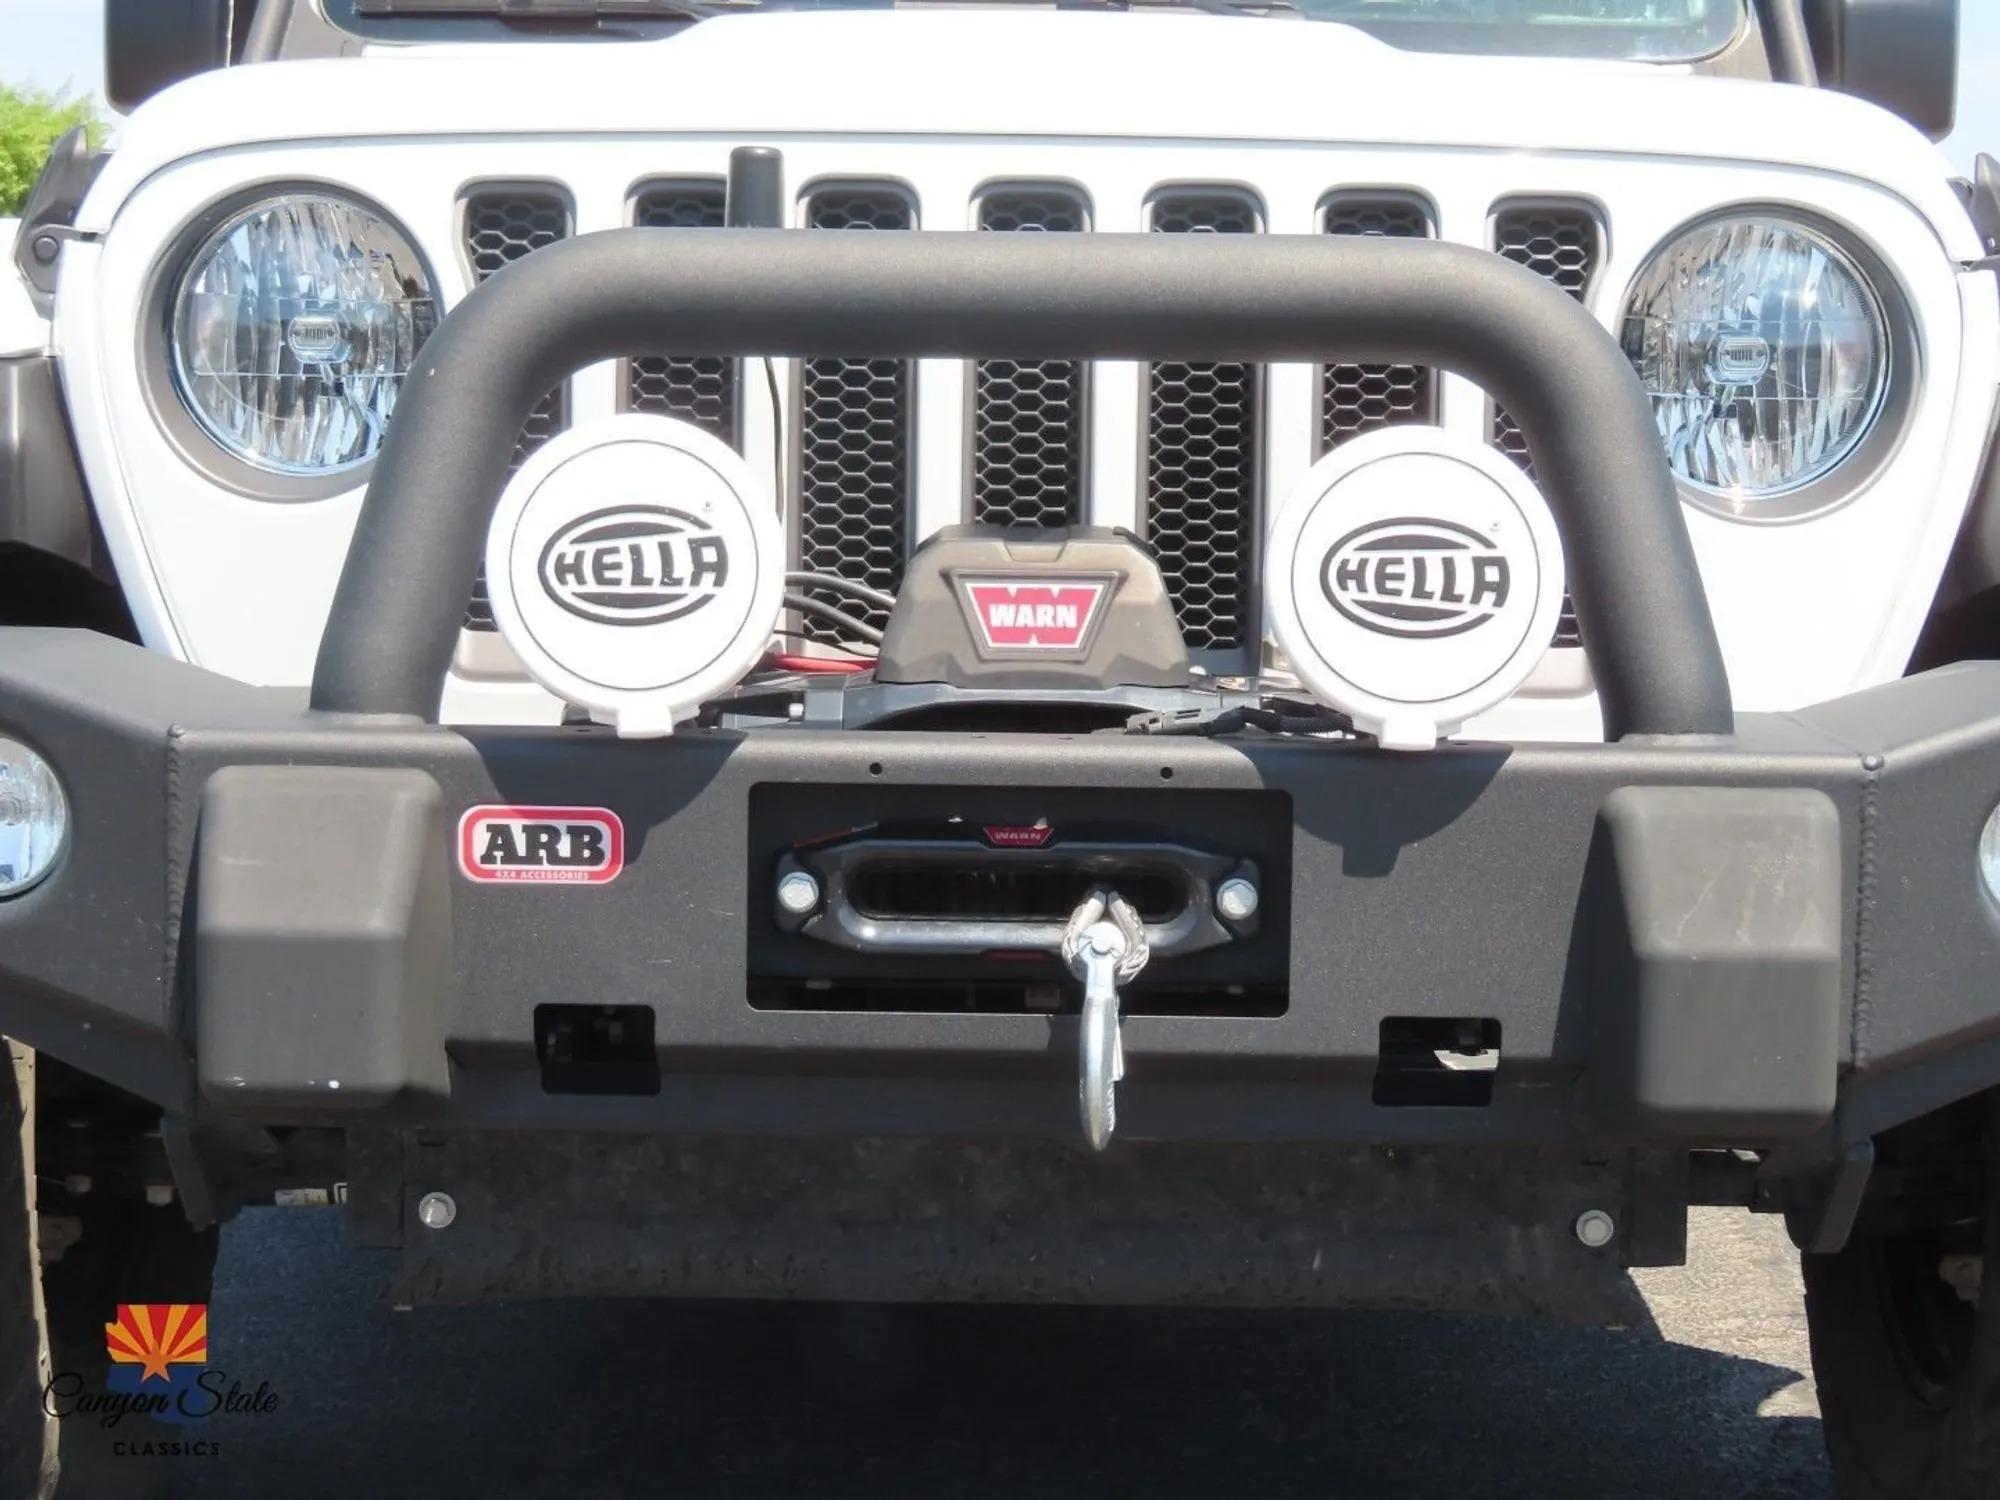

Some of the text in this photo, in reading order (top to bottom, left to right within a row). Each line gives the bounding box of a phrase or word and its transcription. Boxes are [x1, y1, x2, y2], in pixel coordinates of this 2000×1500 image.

[554, 536, 729, 588] HELLA
[1336, 556, 1511, 608] HELLA
[989, 603, 1078, 628] WARN
[479, 823, 605, 867] ARB
[995, 831, 1041, 841] WARN
[520, 870, 589, 881] ACCESSORIES
